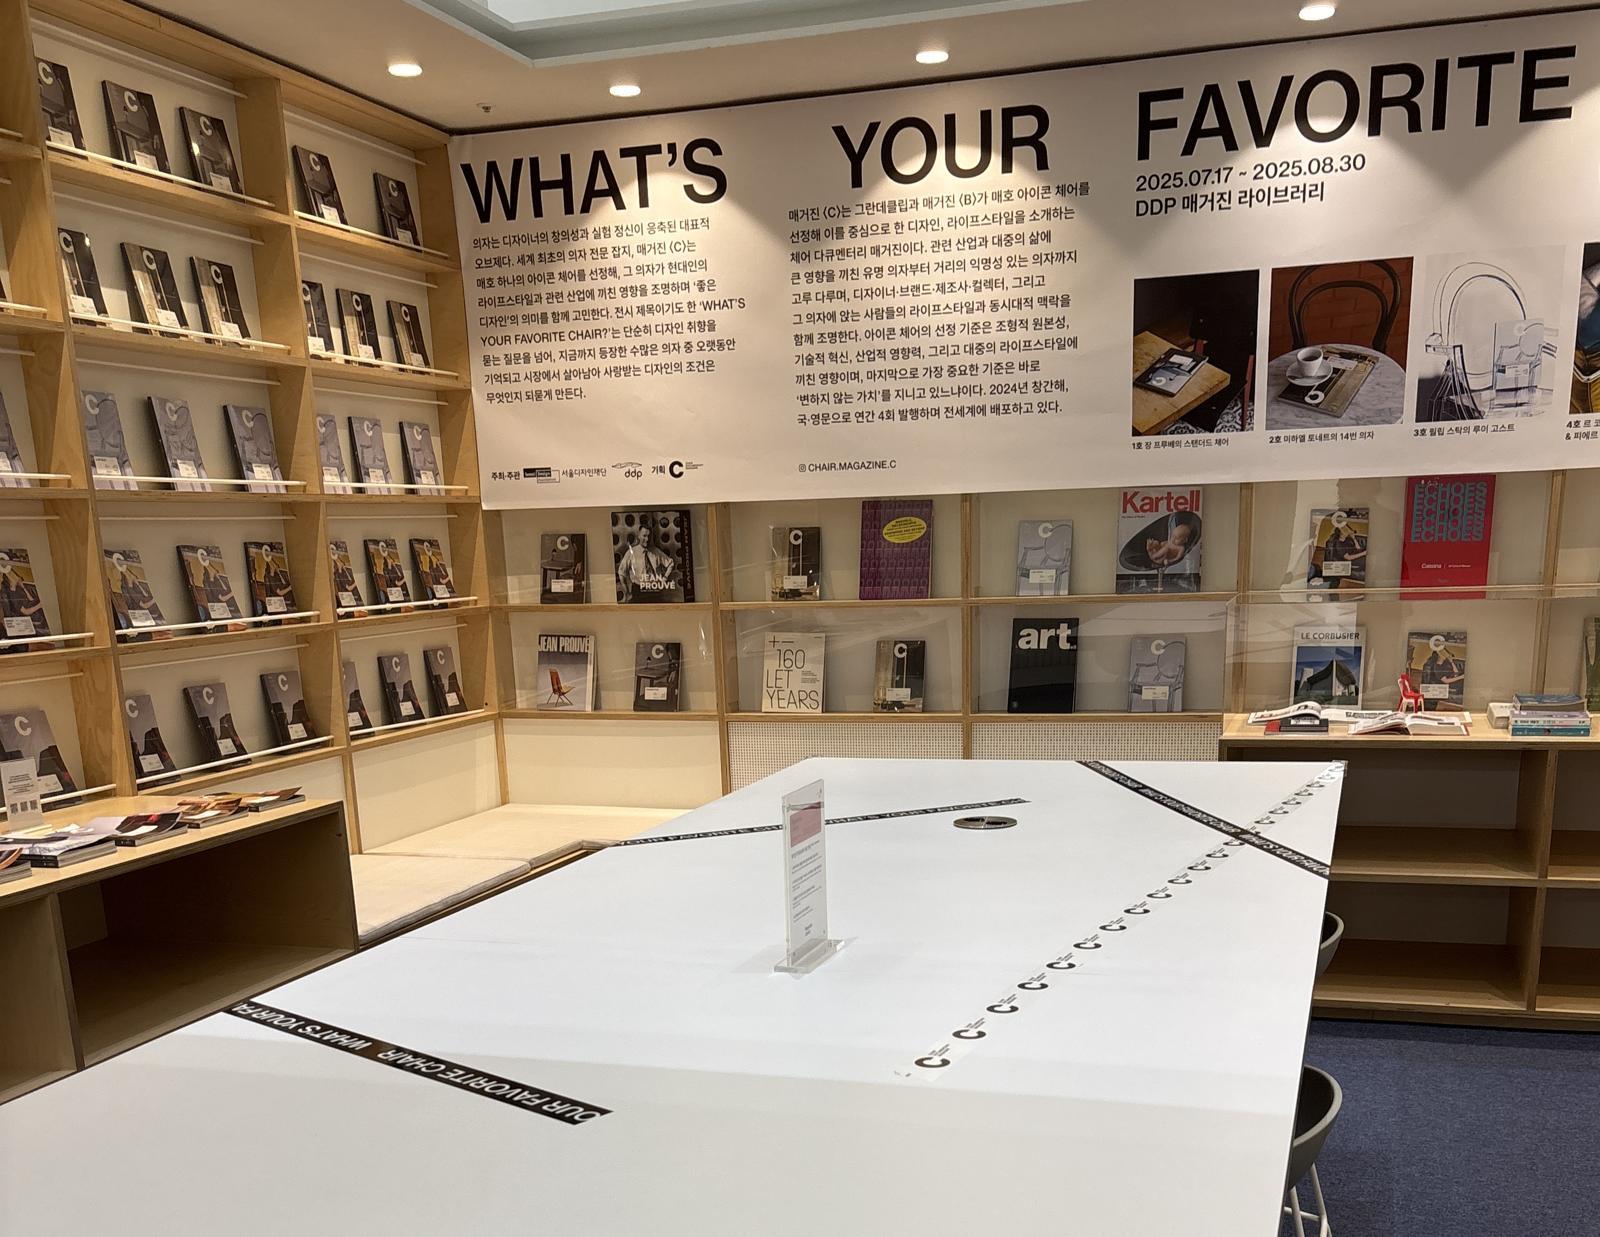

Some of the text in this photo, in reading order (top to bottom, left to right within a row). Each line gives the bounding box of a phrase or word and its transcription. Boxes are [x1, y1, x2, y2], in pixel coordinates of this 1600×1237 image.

[38, 62, 53, 85] C
[124, 90, 138, 112] C
[460, 44, 1577, 224] WHAT'S YOUR FAVORITE
[1136, 167, 1233, 191] 2025.07.17
[1253, 153, 1365, 180] 2025.08.30
[789, 207, 820, 222] 매거진
[855, 198, 919, 216] 그란데클립과
[923, 196, 955, 210] 매거진
[992, 189, 1014, 203] 매호
[1018, 186, 1051, 200] 아이콘
[1056, 182, 1089, 197] 체어를
[1136, 181, 1325, 217] DDP 매거진 라이브러리
[473, 217, 710, 250] 의자는 디자이너의 창의성과 실험 정신이 응축된 대표적
[790, 206, 1075, 244] 선정해 이를 중심으로 한 디자인, 라이프스타일을 소개하는
[475, 256, 514, 269] 오브제다.
[517, 253, 535, 266] 세계
[538, 250, 565, 264] 최초의
[569, 249, 587, 262] 의자
[590, 247, 608, 260] 전문
[612, 245, 634, 259] 잡지,
[637, 242, 666, 255] 매거진
[790, 230, 1051, 264] 체어 다큐멘터리 매거진이다. 관련 산업과 대중의 삶에
[477, 258, 707, 289] 매호 하나의 아이콘 체어를 선정해, 그 의자가 현대인의
[791, 250, 1077, 285] 큰 영향을 끼친 유명 의자부터 거리의 익명성 있는 의자까지
[522, 312, 548, 325] 의미를
[551, 310, 569, 324] 함께
[573, 308, 612, 321] 고민한다.
[615, 305, 633, 319] 전시
[636, 301, 684, 316] 제목이기도
[687, 301, 696, 313] 한
[481, 335, 511, 347] YOUR
[515, 331, 565, 344] FAVORITE
[624, 324, 651, 338] 단순히
[655, 322, 684, 335] 디자인
[687, 319, 716, 333] 취향을
[487, 387, 586, 404] 무엇인지 되묻게 만든다.
[833, 391, 853, 404] 않는
[895, 387, 926, 400] 지니고
[930, 384, 986, 399] 있느냐이다.
[989, 382, 1028, 396] 2024년
[1031, 380, 1068, 393] 창간해,
[855, 410, 875, 423] 연간
[878, 409, 895, 422] 4회
[898, 406, 941, 422] 발행하며
[944, 405, 986, 419] 전세계에
[990, 402, 1034, 416] 배포하고
[1037, 400, 1062, 414] 있다.
[1491, 424, 1515, 433] 고스트
[1566, 419, 1581, 428] 4호
[1359, 431, 1374, 440] 의자
[625, 469, 642, 480] ddp
[669, 460, 684, 478] C
[808, 460, 896, 472] CHAIR.MAGAZINE.C
[1122, 490, 1201, 513] Kartell
[1039, 522, 1053, 538] C
[1332, 511, 1347, 528] C
[557, 536, 569, 550] C
[790, 530, 802, 545] C
[640, 574, 663, 582] JEAN
[1301, 632, 1360, 640] LE CORBUSIER
[652, 645, 664, 659] C
[777, 649, 806, 669] 160
[893, 643, 907, 658] C
[278, 675, 288, 691] C
[766, 669, 792, 688] LET
[203, 687, 214, 704] C
[766, 690, 819, 710] YEARS
[15, 716, 31, 736] C
[252, 1008, 304, 1030] YOUR
[377, 1050, 446, 1073] CHAIR
[437, 1069, 550, 1106] FAVORITE
